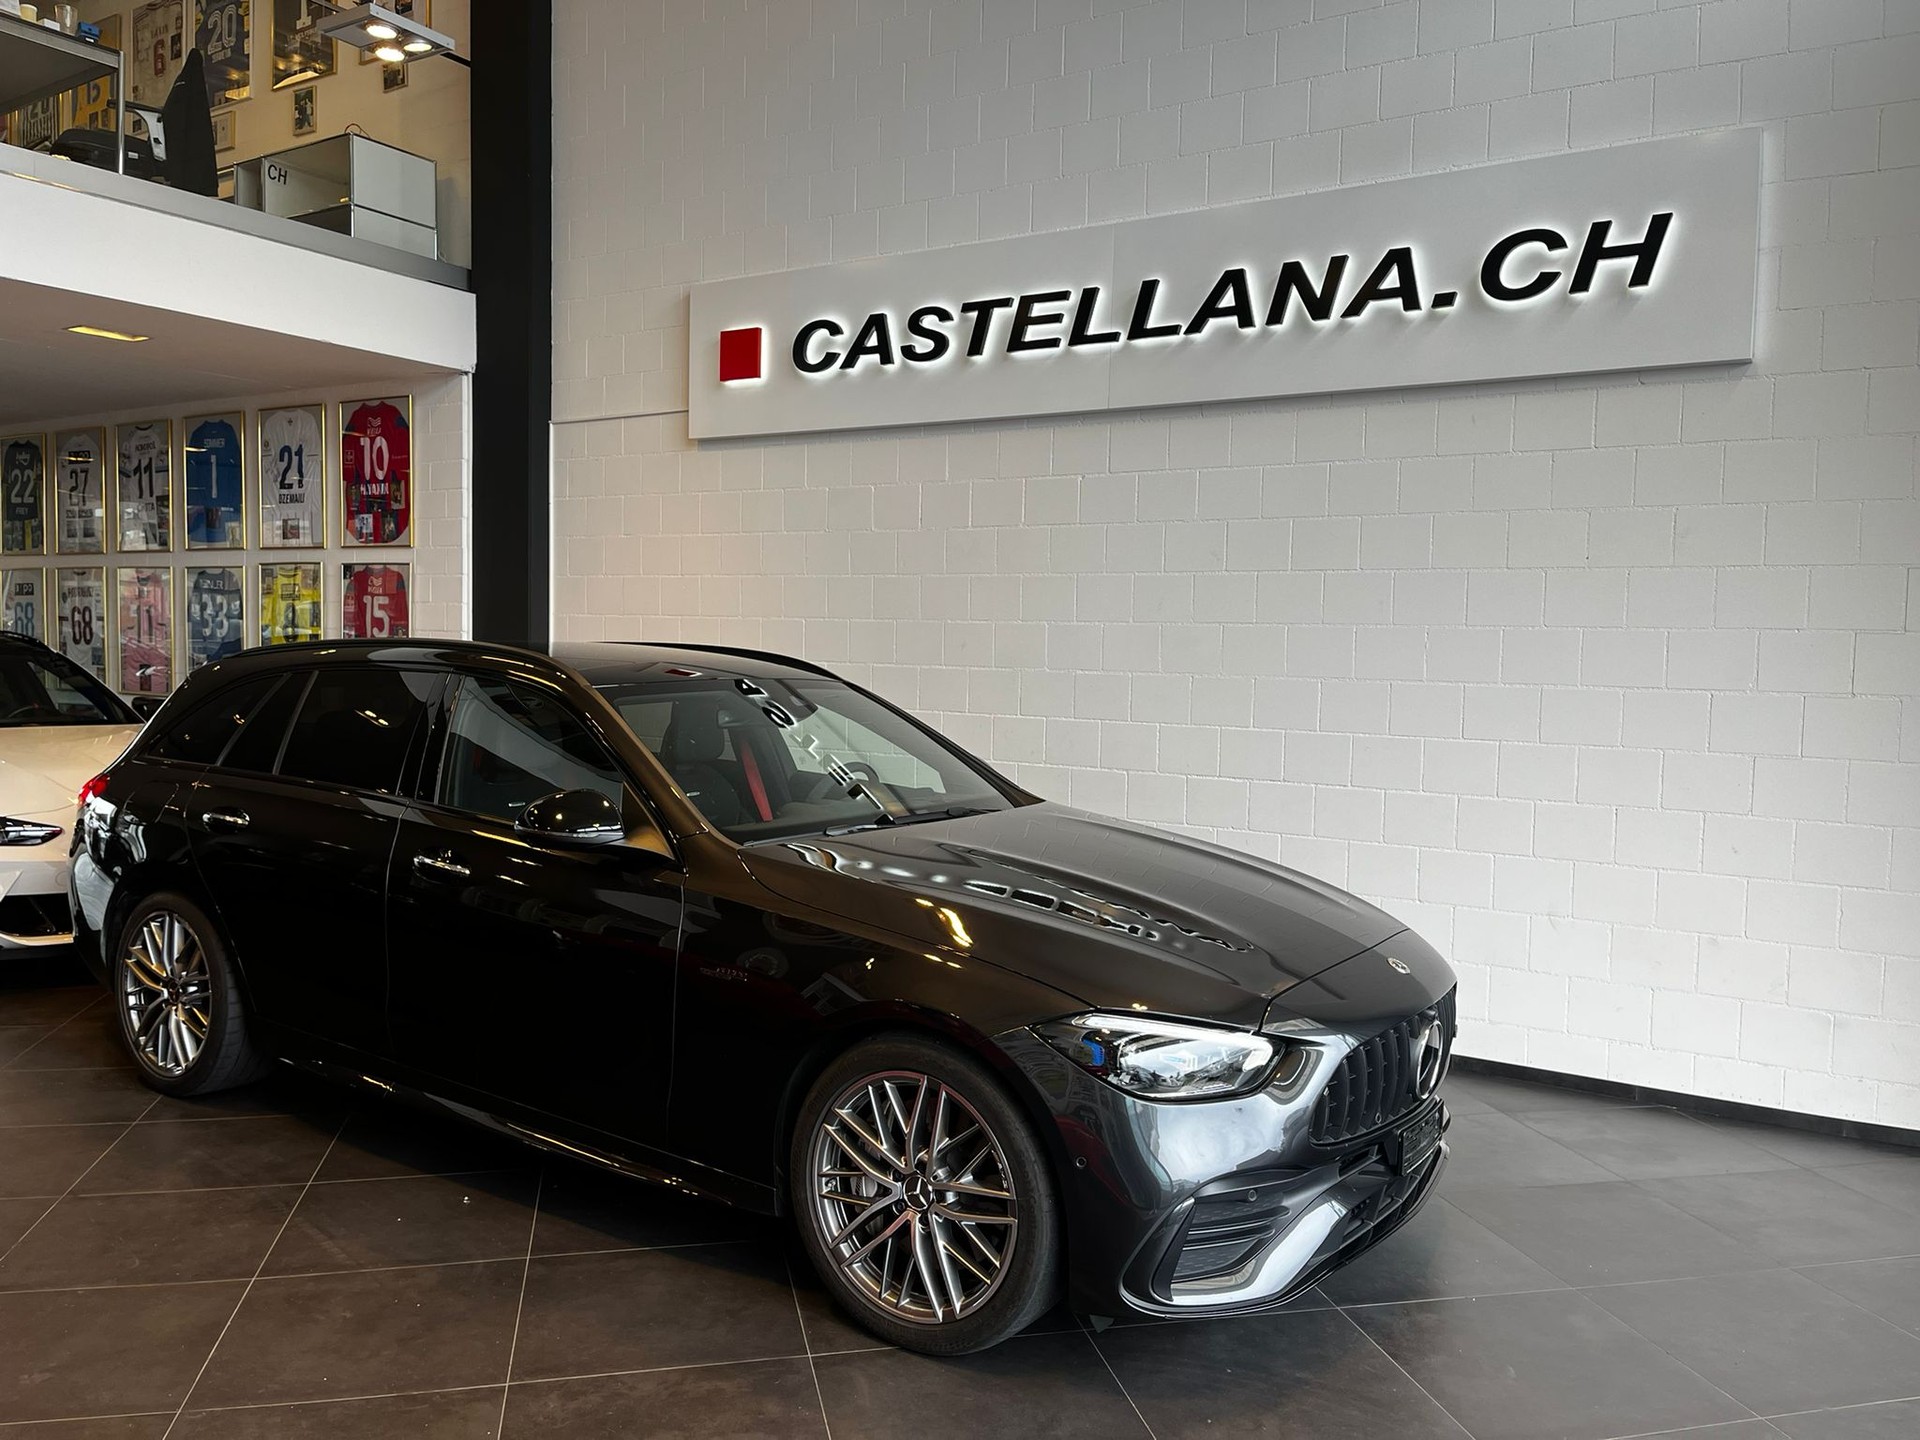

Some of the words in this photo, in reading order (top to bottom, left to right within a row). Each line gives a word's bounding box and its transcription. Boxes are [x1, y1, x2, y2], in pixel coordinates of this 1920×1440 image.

[208, 4, 237, 55] 20
[268, 164, 288, 185] CH
[791, 211, 1674, 374] CASTELLANA.CH
[133, 457, 155, 499] 11
[210, 454, 218, 499] 1
[279, 444, 304, 490] 21
[360, 436, 390, 481] 10
[10, 468, 35, 504] 22
[69, 468, 90, 507] 27
[14, 601, 35, 638] 68
[71, 605, 94, 646] 68
[201, 593, 229, 638] 33
[362, 595, 391, 638] 15
